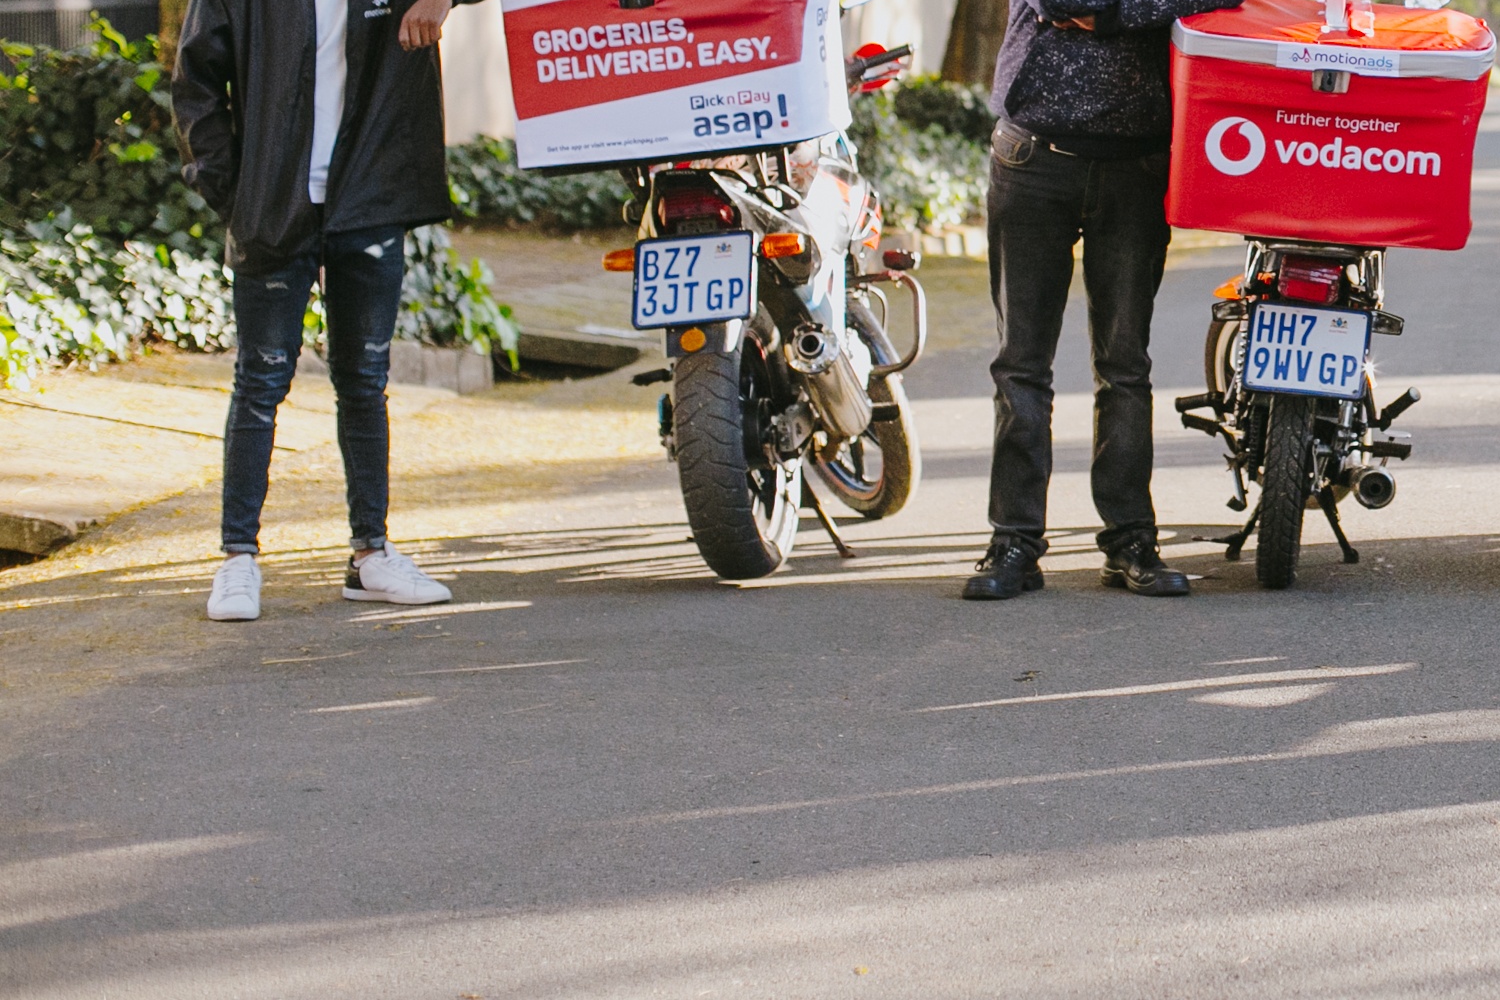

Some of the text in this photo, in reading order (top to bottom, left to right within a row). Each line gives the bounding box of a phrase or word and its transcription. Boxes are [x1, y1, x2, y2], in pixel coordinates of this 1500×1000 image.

[532, 18, 694, 55] GROCERIES,
[537, 36, 777, 83] DELIVERED. EASY.
[1314, 53, 1393, 68] motionads
[690, 91, 770, 110] Pick n Pay
[694, 94, 788, 139] asap!
[1276, 110, 1400, 133] Further together
[1275, 137, 1441, 177] vodacom
[643, 246, 701, 282] BZ7
[1256, 311, 1318, 346] HH7
